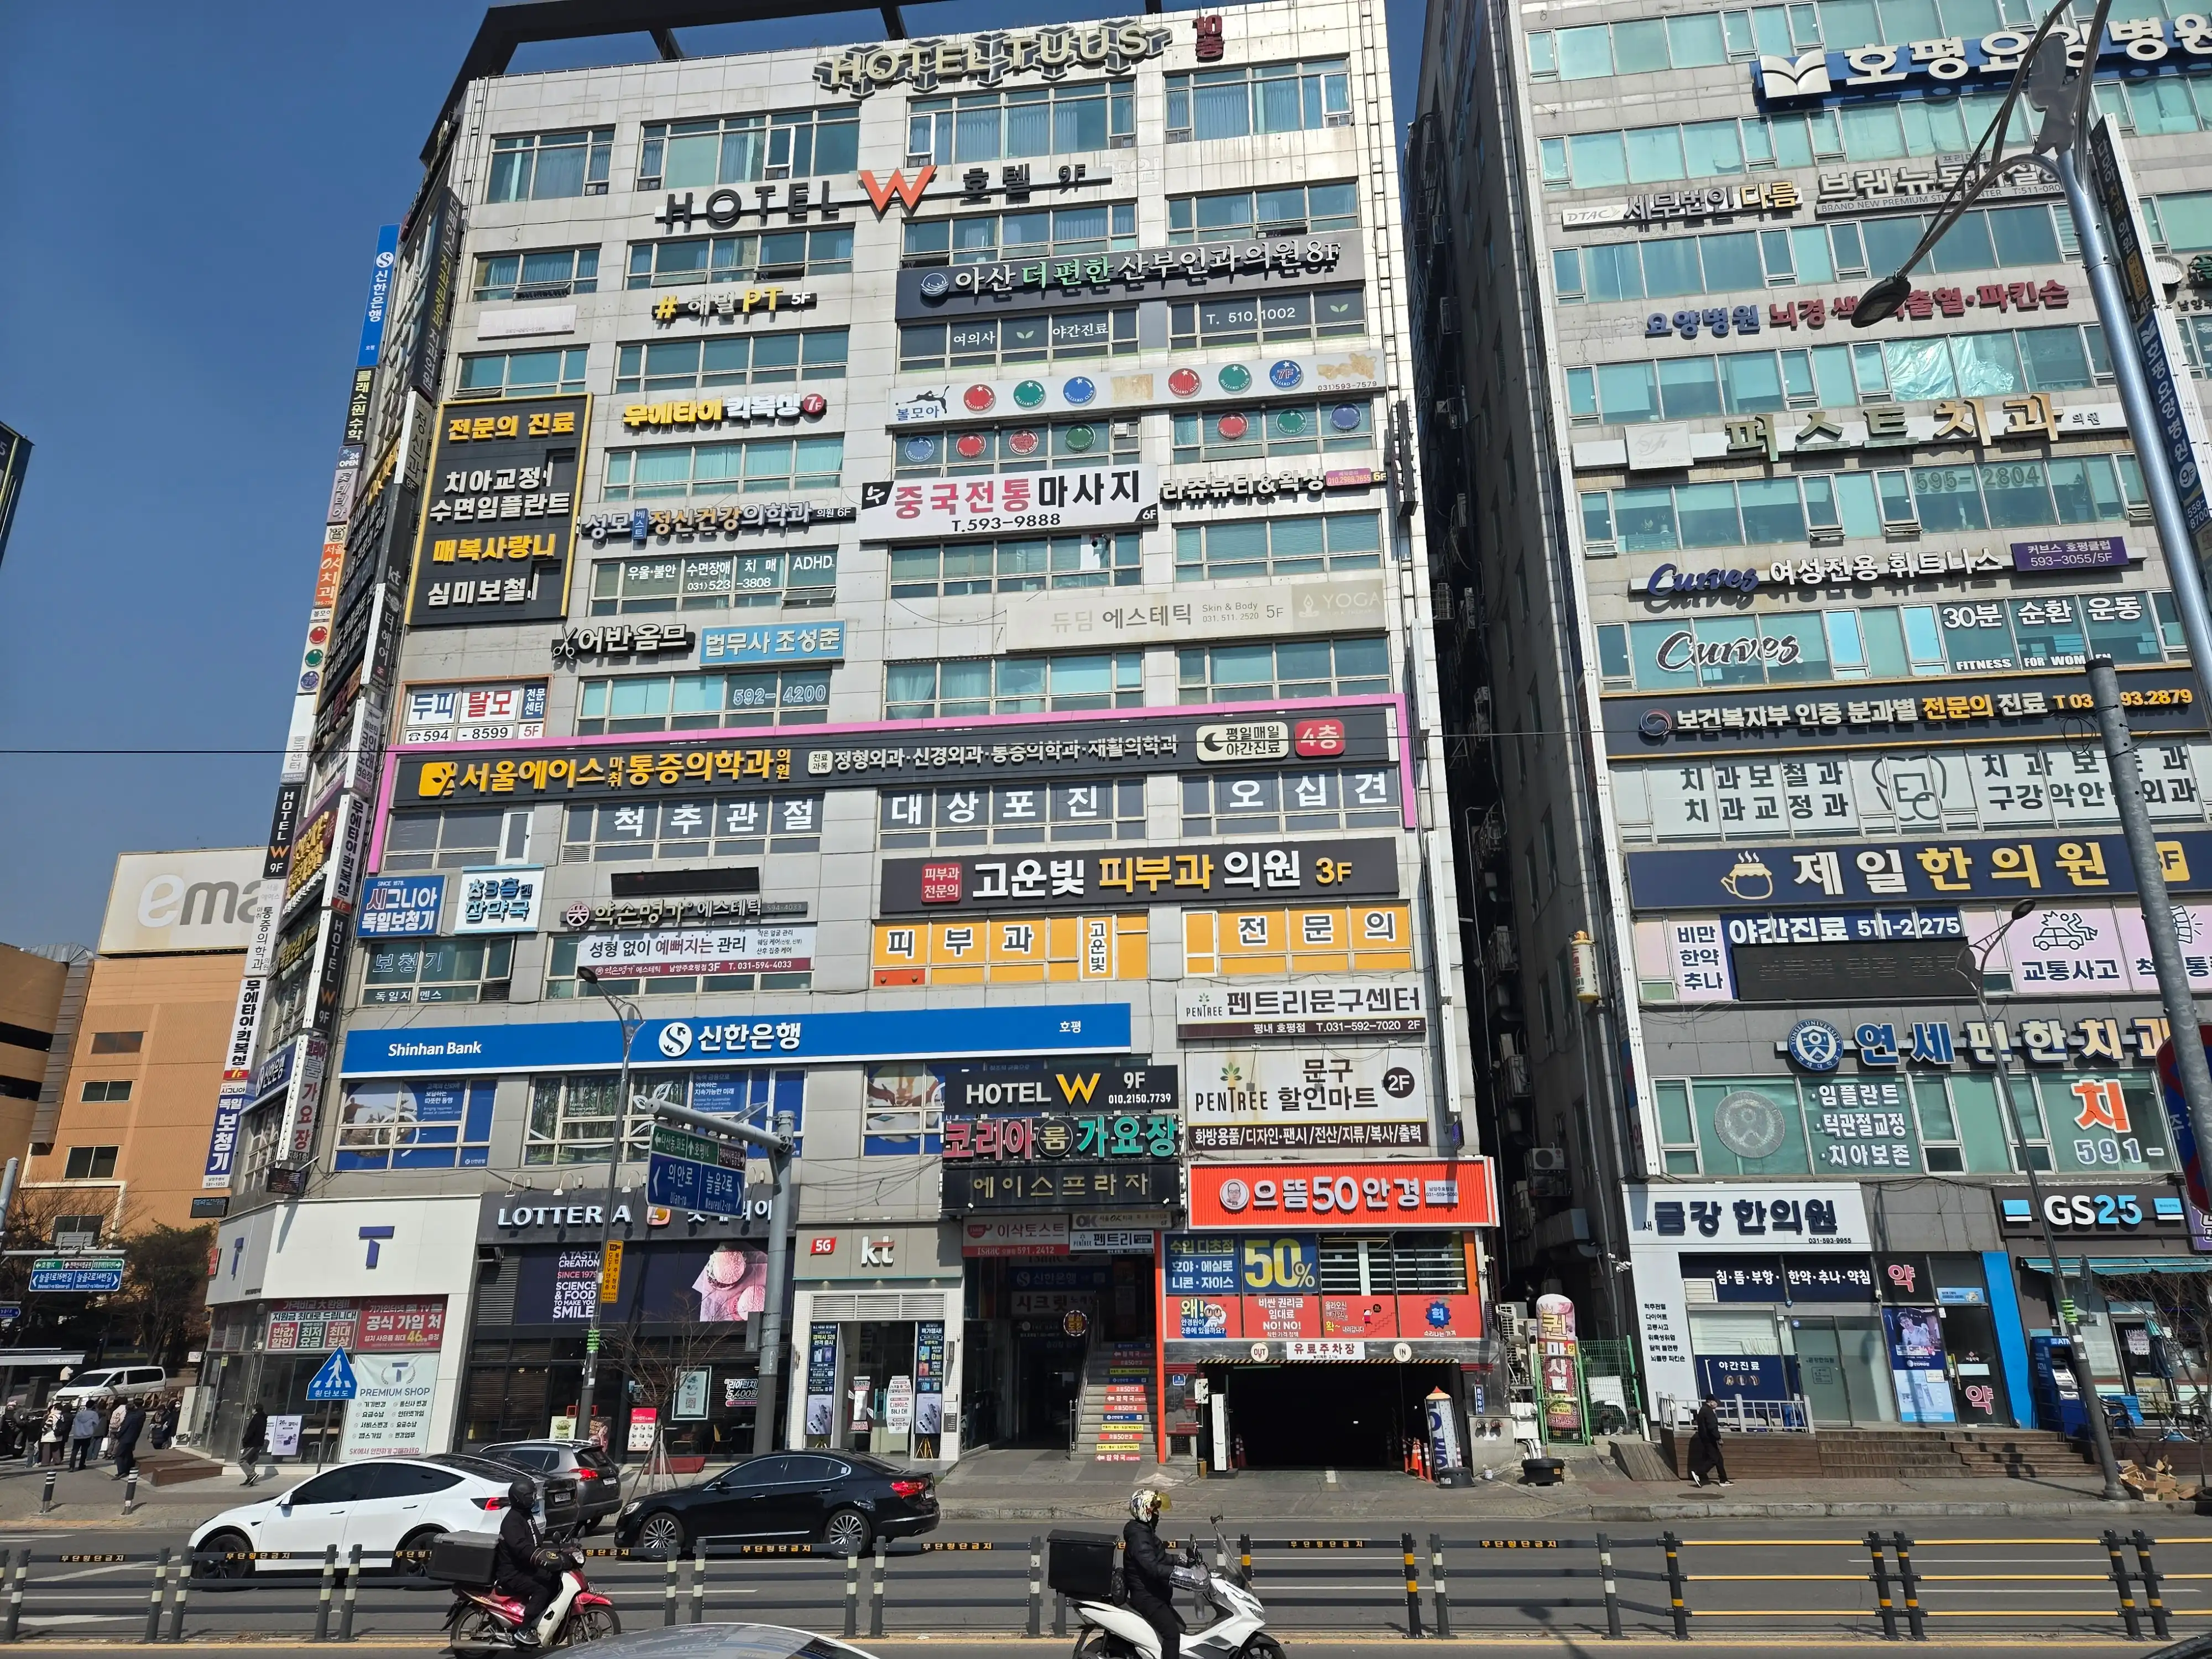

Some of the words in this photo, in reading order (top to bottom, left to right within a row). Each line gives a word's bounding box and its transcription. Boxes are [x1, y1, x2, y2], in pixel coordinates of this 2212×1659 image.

[665, 180, 839, 225] HOTEL
[962, 163, 1031, 200] 호텔
[1058, 164, 1086, 184] 9F
[1624, 186, 1735, 222] 세무법인
[1739, 180, 1799, 210] 다름
[368, 270, 388, 322] 신한은행
[953, 331, 996, 347] 여의사
[1052, 323, 1109, 338] 야간진료
[1227, 307, 1297, 323] 510.1002
[624, 399, 723, 427] 무에타이
[726, 393, 801, 419] 킥복싱
[807, 397, 822, 411] 7F
[896, 406, 940, 421] 볼모아
[448, 415, 520, 441] 전문의
[528, 411, 576, 436] 진료
[444, 466, 541, 494] 치아교정
[1373, 472, 1387, 482] 6F
[429, 492, 571, 521] 수면임플란트
[1142, 509, 1156, 520] 6F
[584, 513, 630, 541] 성모
[649, 502, 813, 536] 정신건강의학과
[816, 508, 834, 518] 의원
[837, 508, 852, 518] 6F
[432, 533, 557, 563] 매복사랑니
[2027, 543, 2062, 555] 커브스
[2065, 540, 2112, 552] 호평클럽
[2030, 552, 2114, 567] 593-3055/5F
[1647, 563, 1760, 597] Curves
[1770, 554, 1879, 585] 여성전용
[1888, 547, 2003, 578] 휘트니스
[427, 578, 526, 607] 심미보철
[1102, 603, 1192, 629] 에스테틱
[1202, 604, 1223, 613] Skin
[1235, 601, 1258, 611] Body
[1266, 604, 1284, 619] 5F
[1943, 603, 2003, 629] 30분
[2017, 599, 2073, 625] 순환
[2088, 596, 2142, 620] 운동
[578, 624, 687, 653] 어반옴므
[705, 632, 771, 656] 법무사
[775, 628, 841, 652] 조성준
[1656, 630, 1802, 672] Curves
[411, 693, 457, 720] 두피
[468, 690, 513, 718] 탈모
[526, 688, 546, 702] 전문
[525, 701, 544, 715] 센터
[1225, 724, 1280, 740] 평일매일
[1300, 724, 1340, 750] 4층
[812, 753, 829, 762] 진료
[1225, 742, 1281, 757] 야간진료
[812, 762, 829, 771] 과목
[276, 791, 294, 841] HOTEL
[269, 845, 290, 859] W
[270, 862, 284, 873] 9F
[924, 867, 961, 882] 피부과
[972, 859, 1086, 898] 고운빛
[1099, 854, 1214, 894] 피부과
[1223, 849, 1301, 889] 의원
[1316, 856, 1353, 885] 3F
[366, 886, 437, 911] 시그니아
[924, 883, 959, 899] 전문의
[362, 910, 435, 933] 독일보청기
[594, 899, 685, 926] 약손명가
[697, 898, 762, 918] 에스테틱
[1677, 925, 1717, 945] 비만
[589, 941, 618, 959] 성형
[623, 940, 652, 957] 없이
[655, 938, 714, 956] 예뻐지는
[716, 936, 747, 953] 관리
[1679, 948, 1719, 967] 한약
[1683, 972, 1724, 990] 추나
[1186, 1005, 1223, 1018] PENTREE
[1227, 987, 1420, 1016] 펜트리문구센터
[1253, 1024, 1273, 1034] 평내
[1276, 1022, 1306, 1034] 호평점
[1407, 1020, 1421, 1030] 2F
[388, 1042, 444, 1057] Shinhan
[446, 1041, 482, 1055] Bank
[697, 1021, 802, 1052] 신한은행
[1059, 1020, 1082, 1034] 호평
[221, 1086, 245, 1094] 시그니아
[966, 1082, 1051, 1105] HOTEL
[1055, 1072, 1101, 1105] W
[1387, 1074, 1410, 1092] 2F
[218, 1098, 243, 1110] 독일
[1108, 1093, 1171, 1104] 010.2150.7739
[1196, 1087, 1269, 1113] PENTREE
[1277, 1086, 1378, 1112] 할인마트
[1818, 1084, 1901, 1107] 임플란트
[2070, 1078, 2132, 1133] 치
[1823, 1113, 1907, 1139] 턱관절교정
[209, 1113, 237, 1171] 보청기
[1829, 1144, 1911, 1167] 치아보존
[667, 1164, 693, 1187] 의안로
[973, 1173, 1148, 1199] 에이스프라자
[1655, 1200, 1723, 1237] 금강
[1733, 1199, 1838, 1235] 한의원
[2043, 1193, 2143, 1227] GS25
[997, 1223, 1065, 1238] 이삭토스트
[1093, 1233, 1133, 1246] 펜트리
[815, 1239, 832, 1252] 5G
[861, 1234, 895, 1265] kt
[559, 1260, 599, 1268] CREATION
[1244, 1238, 1316, 1289] 50%
[556, 1281, 597, 1291] SCIENCE
[1171, 1277, 1194, 1290] 니콘
[1201, 1276, 1234, 1290] 자이스
[1887, 1264, 1916, 1293] 약
[552, 1306, 594, 1318] SMILE
[1258, 1298, 1276, 1307] 비싼
[1277, 1297, 1304, 1308] 권리금
[273, 1312, 296, 1321] 지원금
[298, 1311, 321, 1321] 최대로
[322, 1311, 357, 1321] 드립니다!
[367, 1315, 393, 1331] 공식
[397, 1314, 424, 1329] 가입
[1269, 1309, 1295, 1319] 임대료
[273, 1327, 294, 1337] 반값
[301, 1327, 322, 1337] 최저
[329, 1327, 349, 1337] 최대
[1262, 1321, 1281, 1330] NO!
[1283, 1320, 1301, 1330] NO!
[271, 1338, 292, 1348] 할인
[300, 1338, 320, 1347] 요금
[1293, 1343, 1355, 1355] 유료주차장
[1399, 1347, 1407, 1356] IN
[1718, 1361, 1760, 1371] 야간진료
[314, 1389, 349, 1398] 횡단보도
[1964, 1385, 1994, 1415] 약
